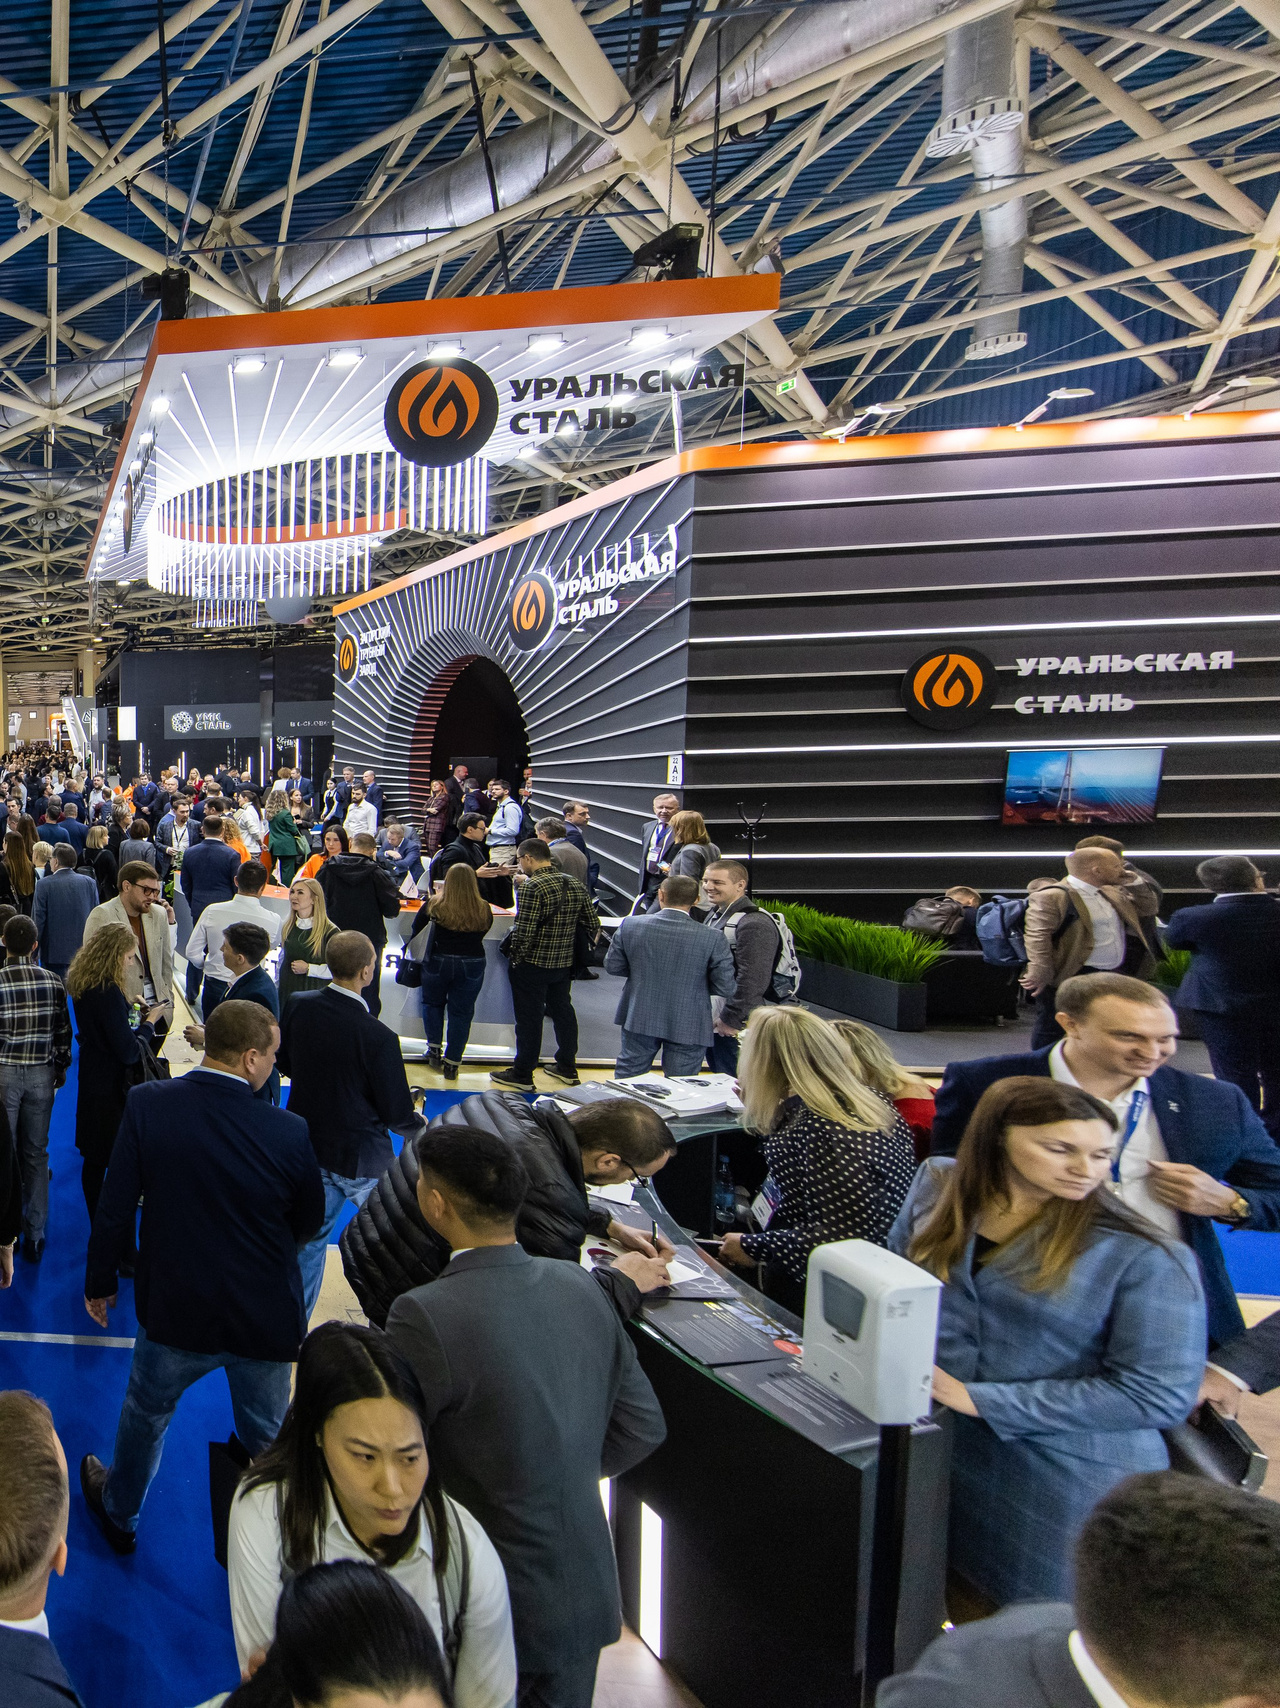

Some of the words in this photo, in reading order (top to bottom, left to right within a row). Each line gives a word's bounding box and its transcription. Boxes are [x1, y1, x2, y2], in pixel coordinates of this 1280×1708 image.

[509, 363, 745, 403] УРАЛЬСКАЯ
[508, 406, 637, 436] СТАЛЬ
[557, 549, 677, 601] УРАЛЬСКАЯ
[558, 595, 619, 625] СТАЛЬ
[1015, 650, 1235, 677] УРАЛЬСКАЯ
[1014, 693, 1135, 715] СТАЛЬ
[195, 720, 232, 731] СТАЛЬ
